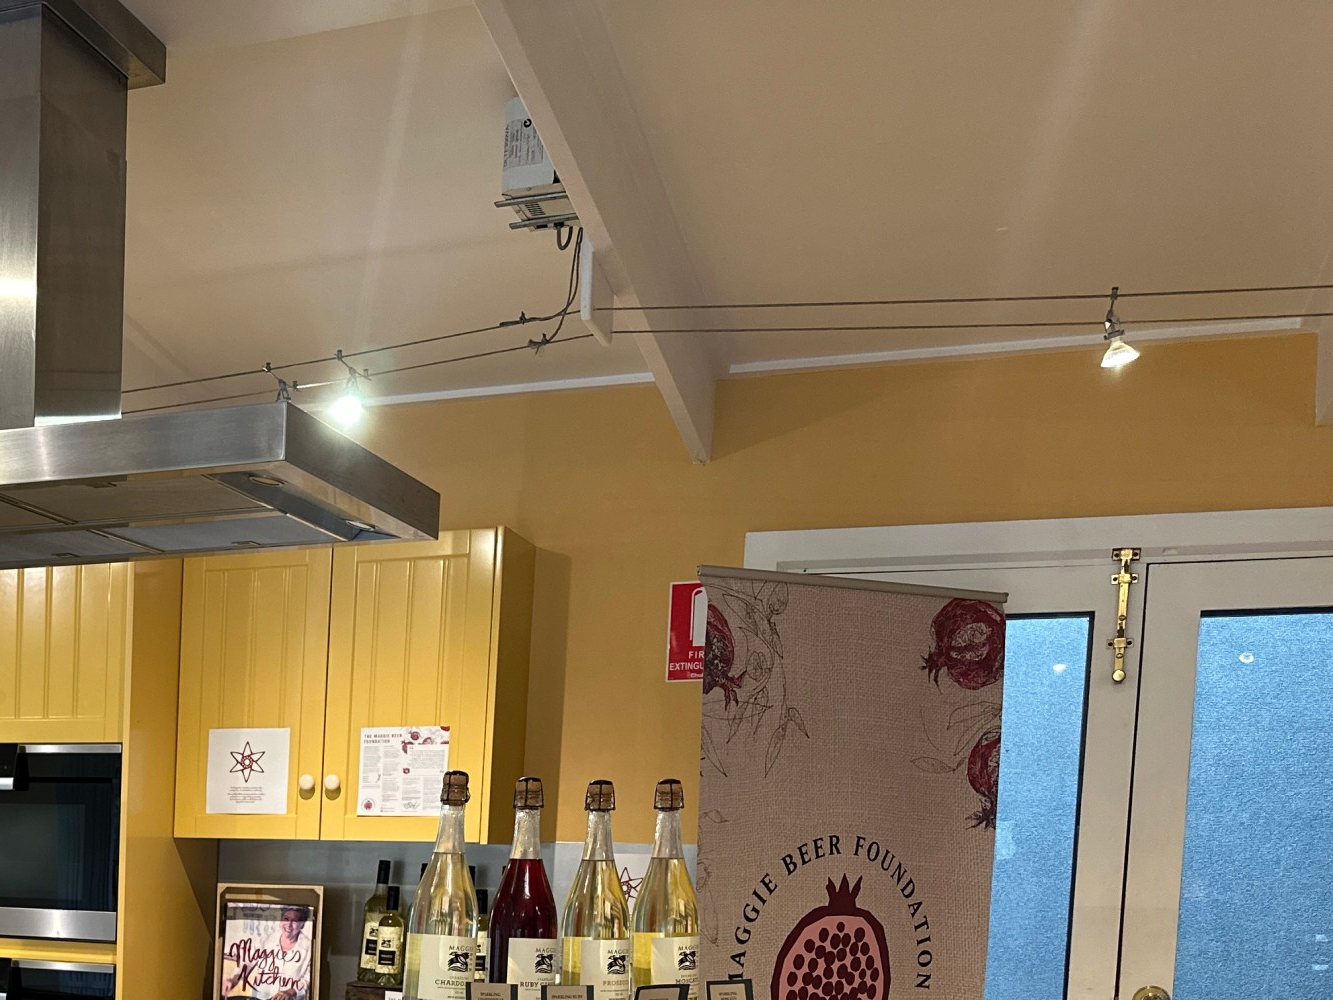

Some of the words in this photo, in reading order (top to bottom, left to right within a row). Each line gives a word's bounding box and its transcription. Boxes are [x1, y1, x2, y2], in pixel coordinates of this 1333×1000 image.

[688, 651, 705, 659] FIR
[669, 661, 704, 671] EXTINGU
[728, 873, 779, 980] AGGIE
[780, 834, 842, 876] BEER
[853, 835, 933, 990] FOUNDATION
[229, 938, 302, 971] Maggie's
[230, 961, 305, 992] Kitchen
[434, 978, 465, 987] CHARDO
